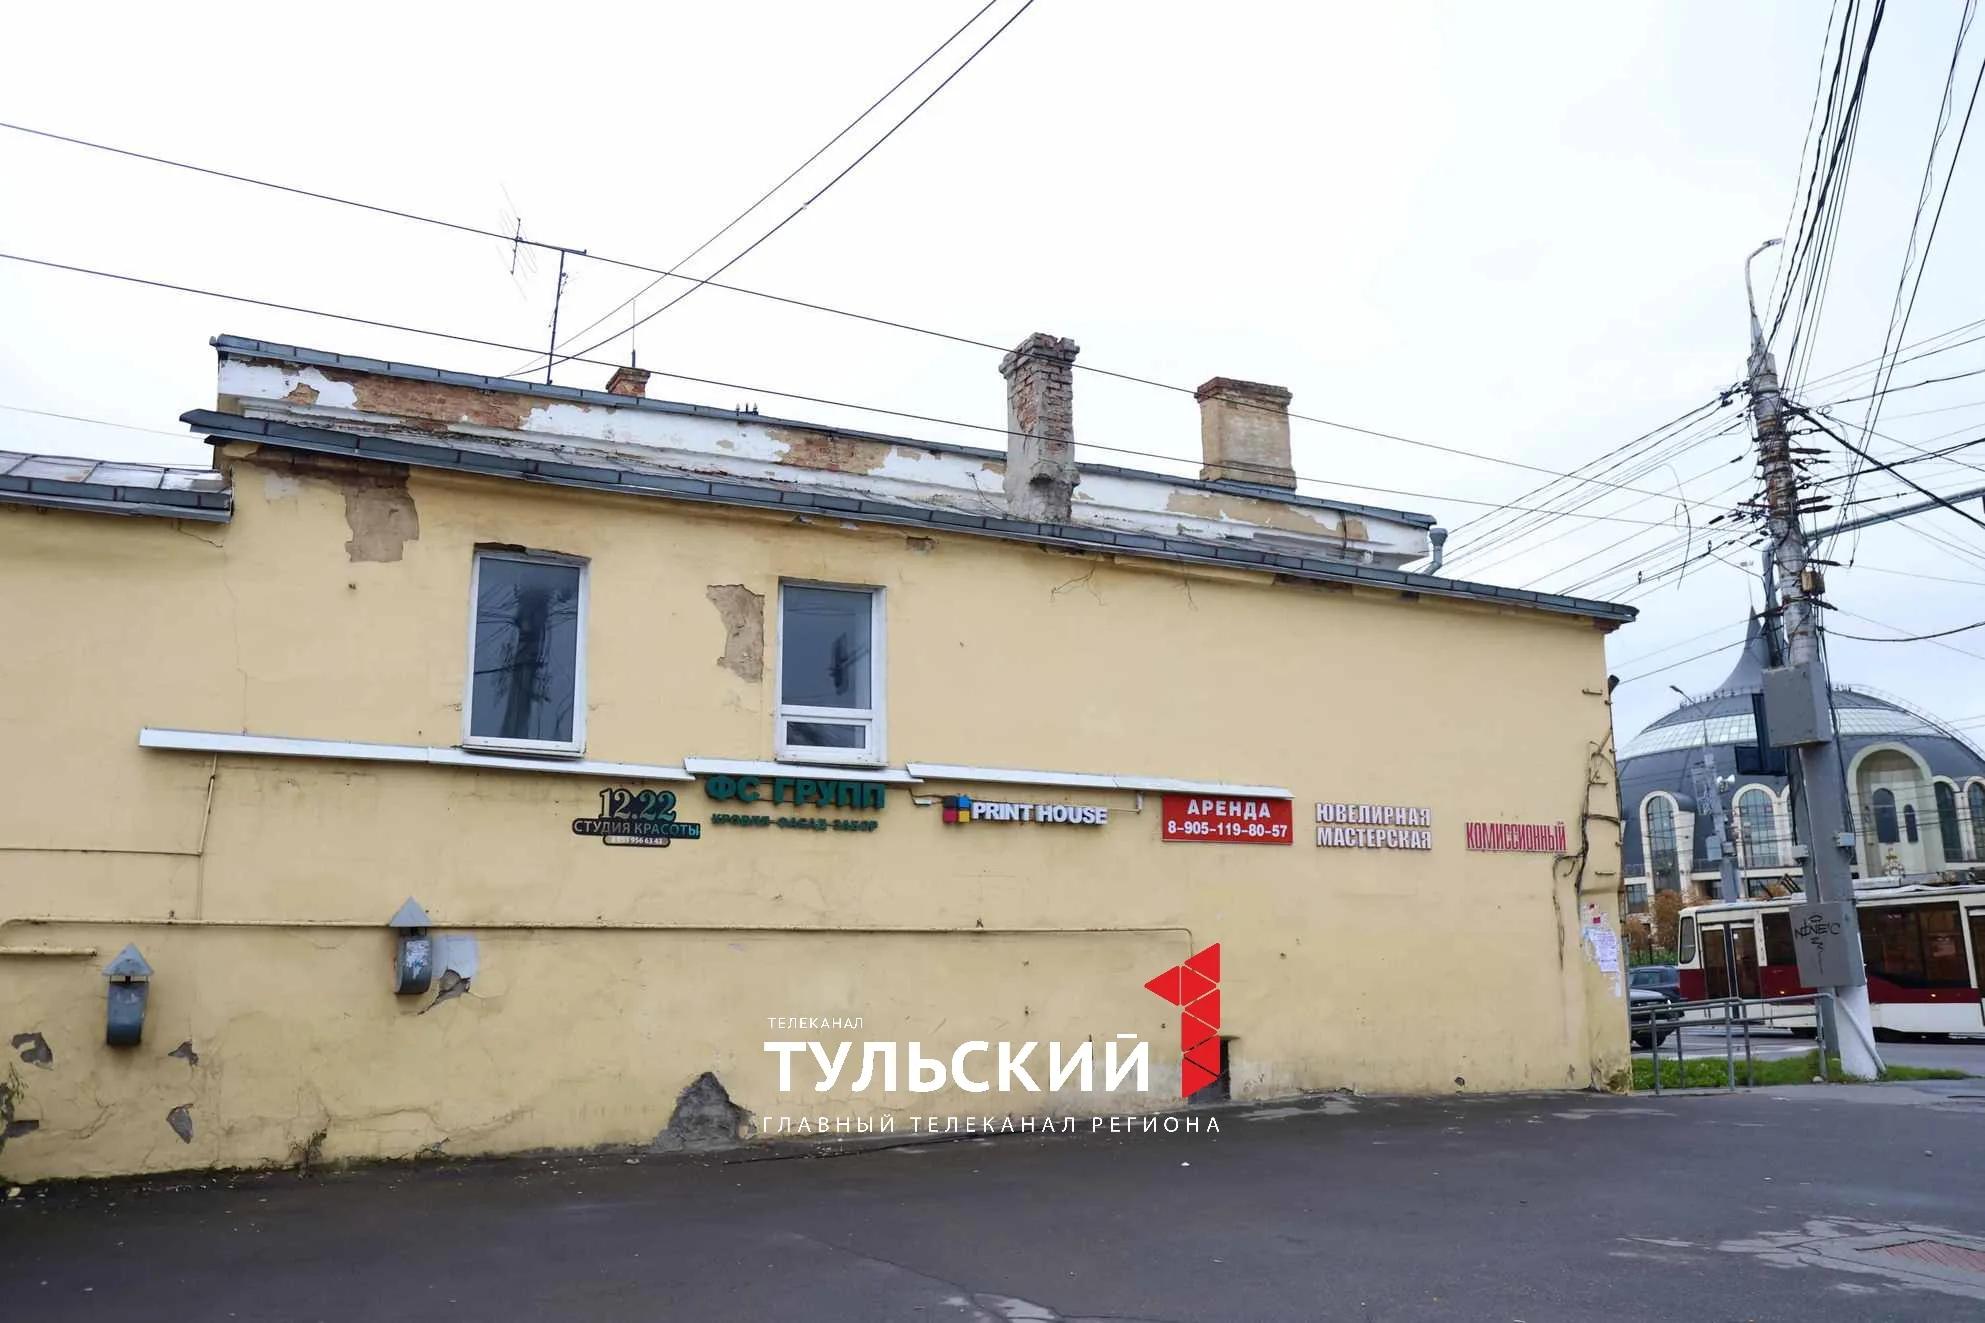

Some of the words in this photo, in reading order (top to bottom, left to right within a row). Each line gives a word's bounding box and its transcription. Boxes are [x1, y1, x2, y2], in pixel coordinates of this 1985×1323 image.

[706, 775, 761, 803] ФС
[773, 777, 886, 809] ГРУПП
[600, 789, 675, 821] 12.22
[971, 802, 1034, 822] PRINT
[1035, 804, 1108, 825] HOUSE
[1186, 799, 1272, 820] АРЕНДА
[1315, 802, 1432, 827] ЮВЕЛИРНАЯ
[574, 820, 630, 835] СТУДИЯ
[634, 821, 699, 837] КРАСОТЫ
[1167, 820, 1288, 838] 8-905-119-80-57
[1316, 826, 1432, 850] МАСТЕРСКАЯ
[1466, 820, 1567, 852] КОМИССИОННЫЙ
